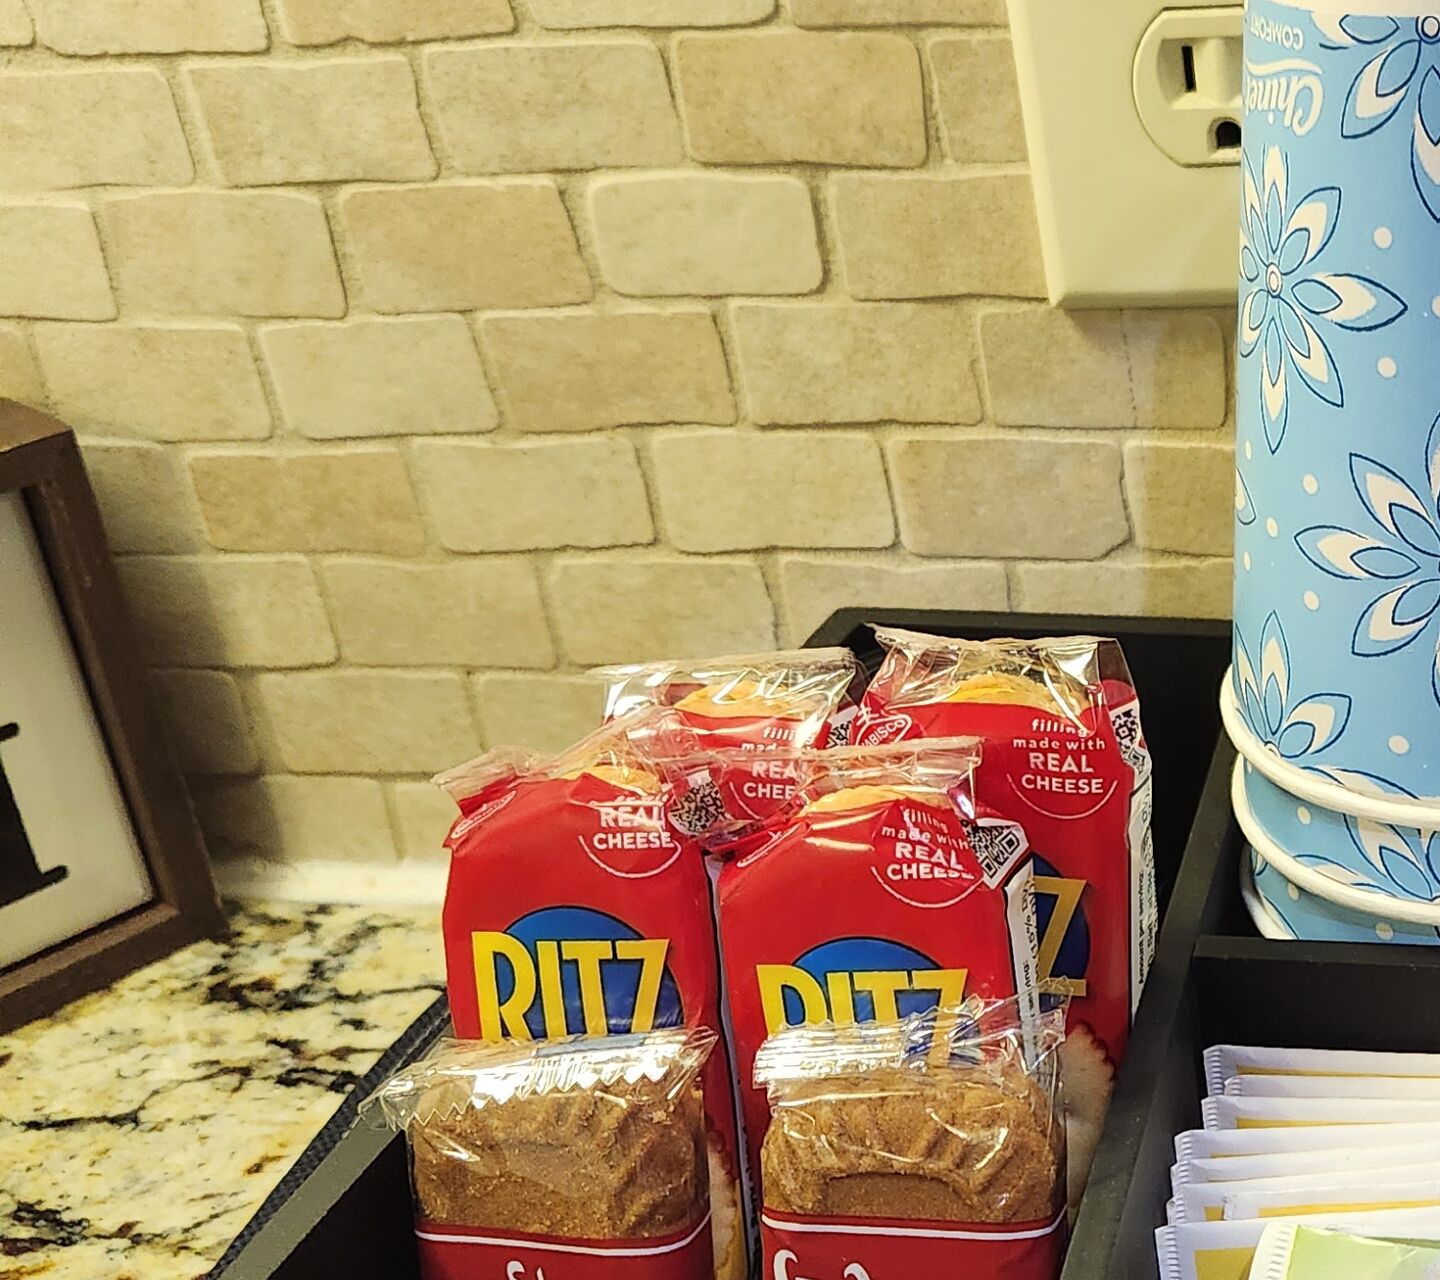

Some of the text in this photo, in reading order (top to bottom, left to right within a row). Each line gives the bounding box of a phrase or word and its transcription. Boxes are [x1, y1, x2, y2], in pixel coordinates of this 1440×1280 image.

[1031, 718, 1088, 738] filling
[1012, 737, 1105, 751] made with
[1029, 752, 1094, 774] REAL
[743, 782, 796, 800] CHEE
[1021, 773, 1105, 795] CHEESE
[600, 806, 663, 829] REAL
[593, 832, 675, 851] CHEESE
[937, 833, 970, 851] with
[895, 842, 964, 870] REAL
[471, 931, 670, 1044] RITZ
